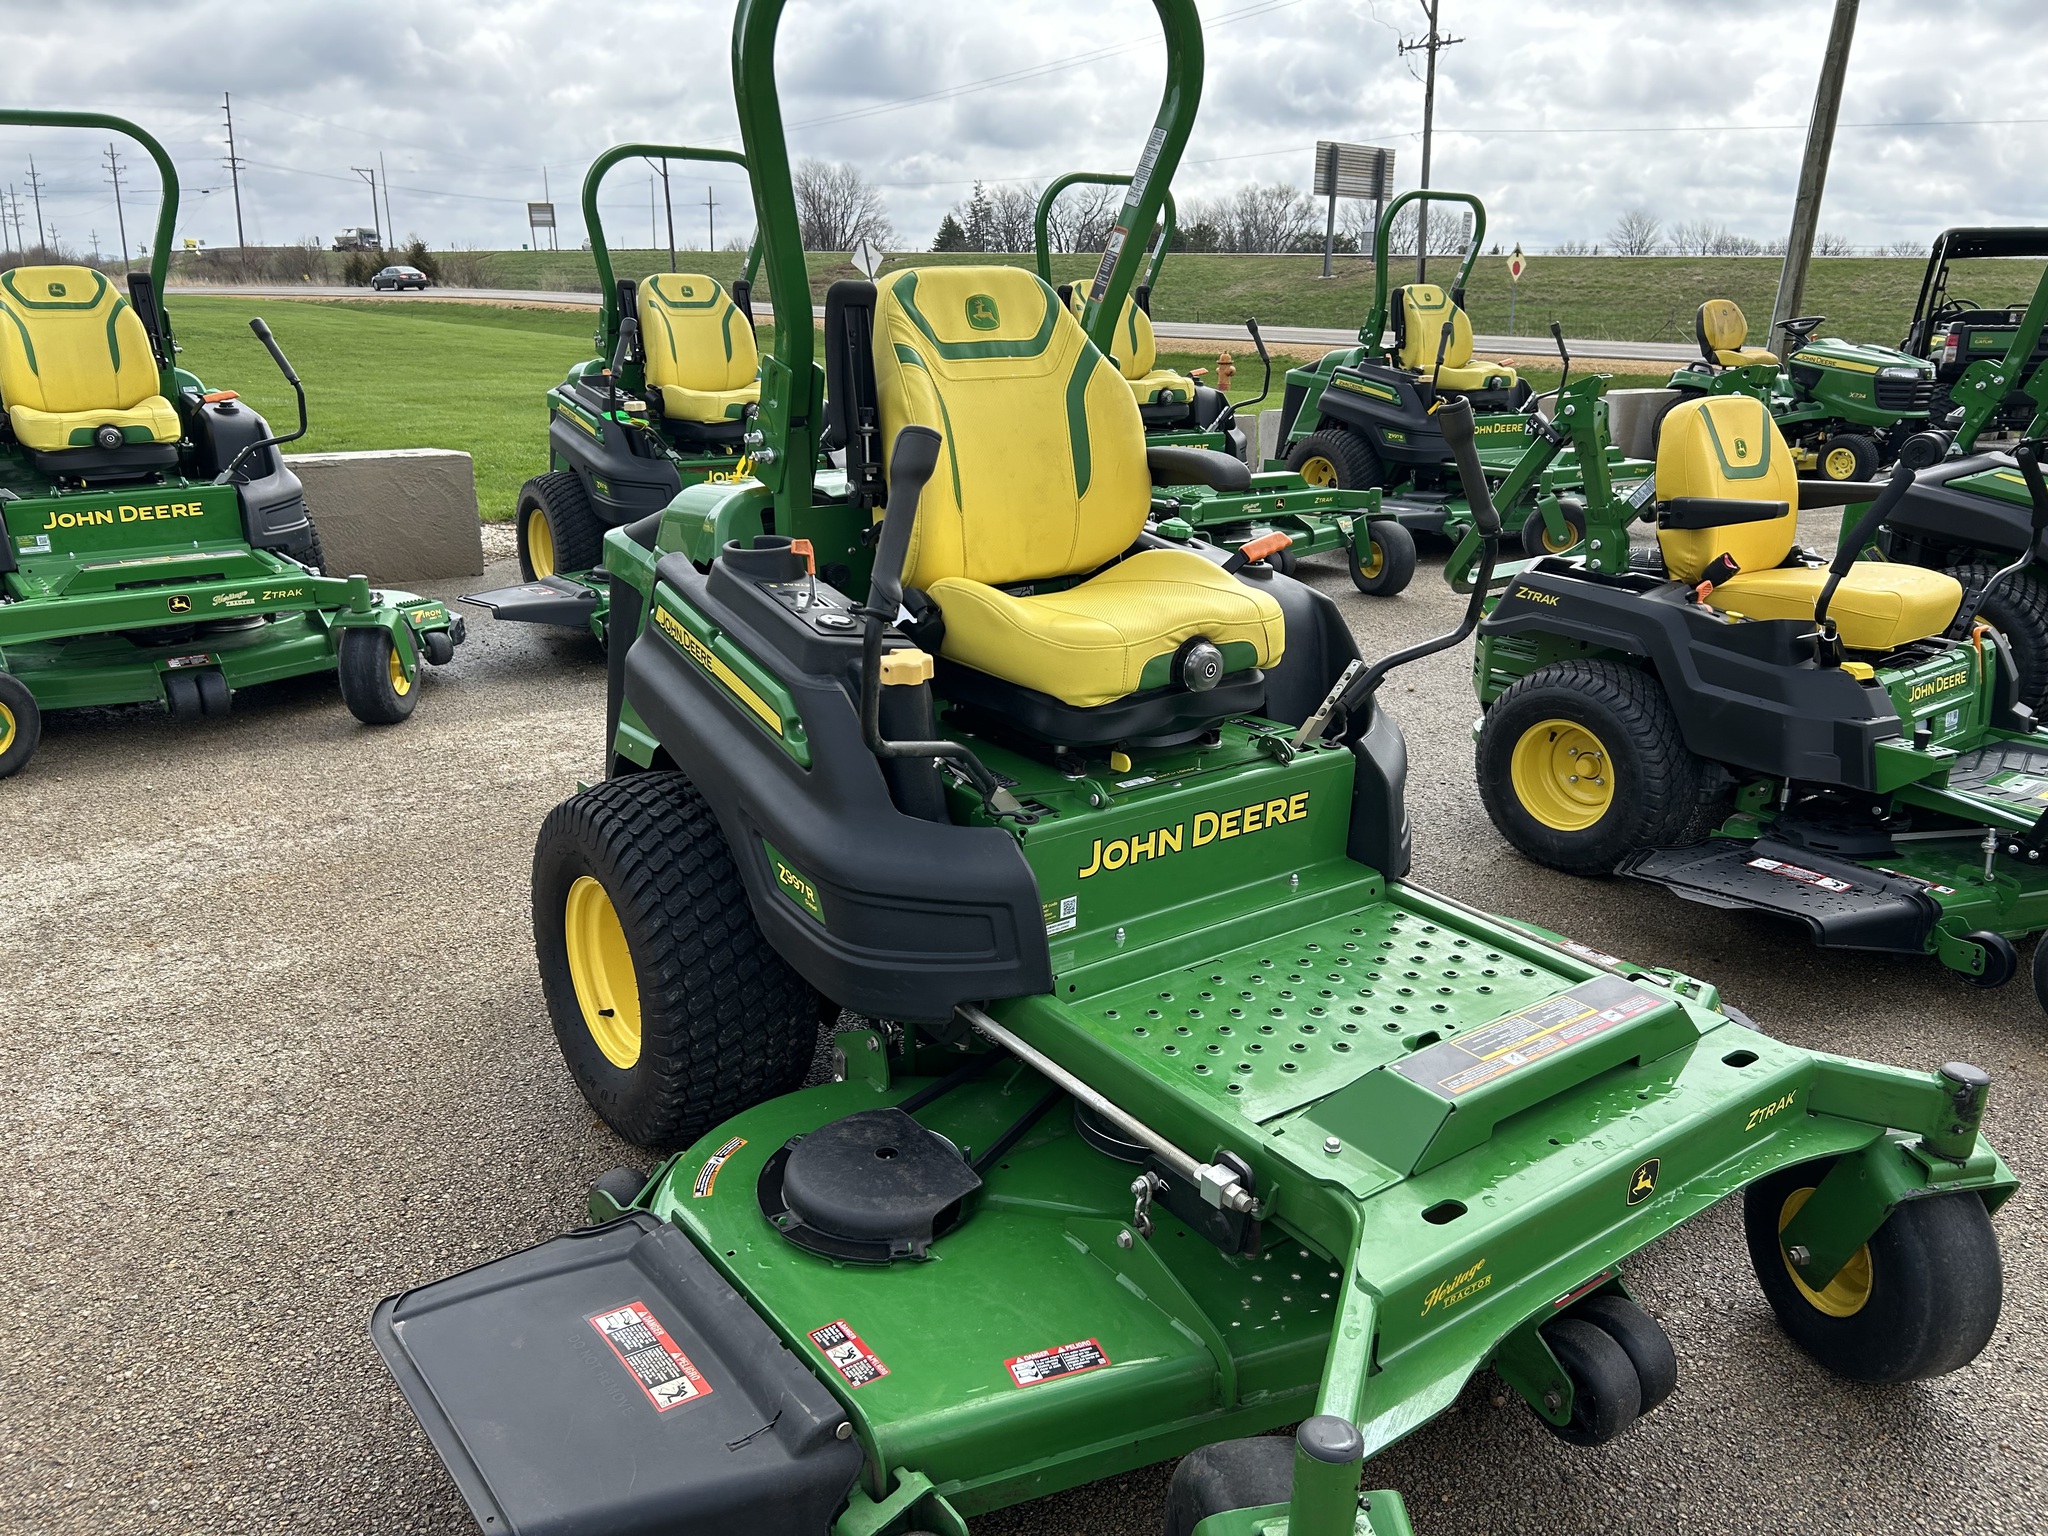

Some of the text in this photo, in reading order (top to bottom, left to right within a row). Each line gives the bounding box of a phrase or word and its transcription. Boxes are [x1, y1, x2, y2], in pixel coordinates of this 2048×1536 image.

[1800, 354, 1838, 367] JOHN DEERE
[1473, 425, 1493, 435] OHN
[1493, 423, 1524, 434] DEERE
[42, 501, 204, 530] JOHN DEERE
[262, 588, 303, 601] ZTRAK
[1515, 586, 1560, 607] ZTRAK
[659, 611, 714, 673] JOHN DEERE
[1908, 671, 1967, 704] JOHN DEERE
[1078, 790, 1310, 879] JOHN DEERE
[1744, 1088, 1799, 1132] ZTRAK
[1420, 1258, 1487, 1317] Heritage
[1443, 1274, 1492, 1309] TRACTOR
[643, 1315, 665, 1337] DANGER
[677, 1356, 701, 1381] PELIGRO
[1023, 1350, 1050, 1361] DANGER
[1064, 1340, 1092, 1351] PELIGRO
[568, 1334, 586, 1349] DO
[580, 1349, 603, 1370] NOT
[596, 1370, 636, 1417] REMOVE
